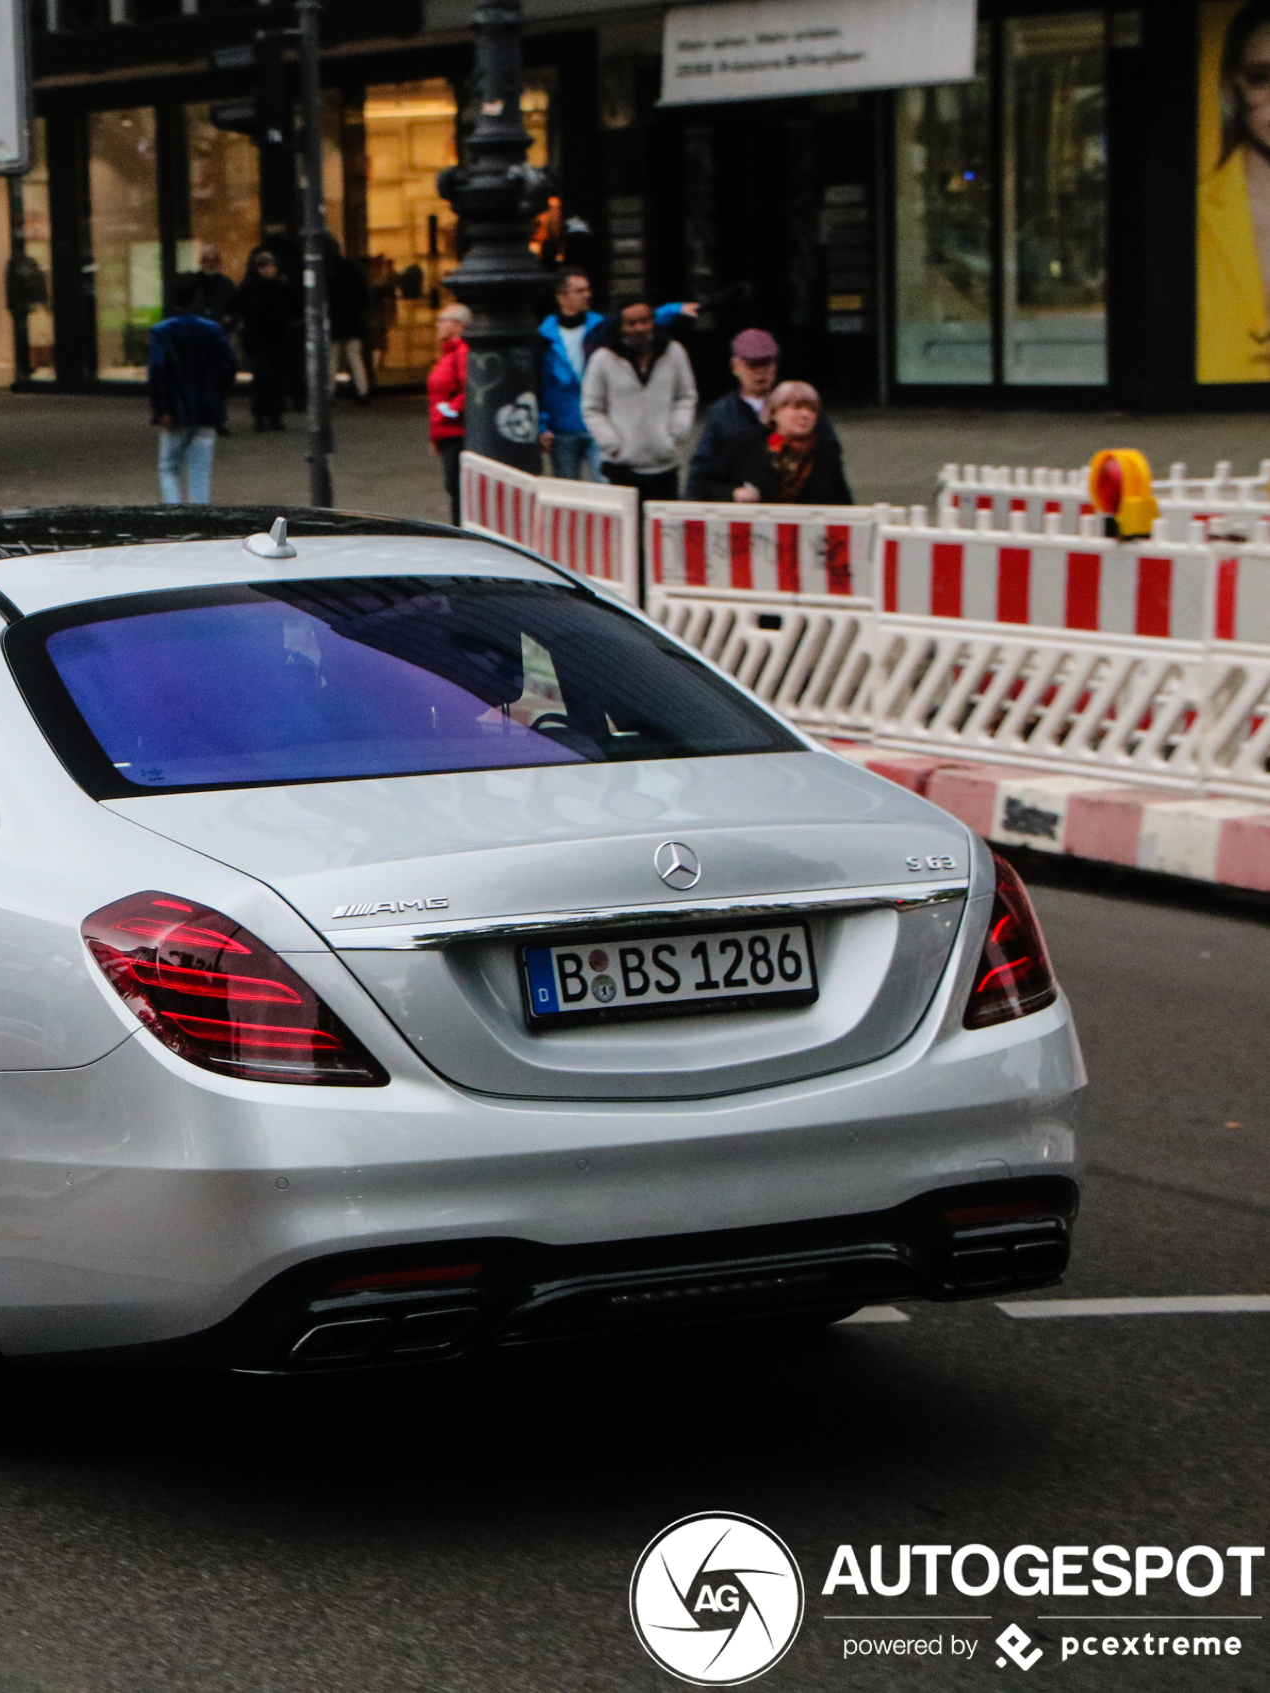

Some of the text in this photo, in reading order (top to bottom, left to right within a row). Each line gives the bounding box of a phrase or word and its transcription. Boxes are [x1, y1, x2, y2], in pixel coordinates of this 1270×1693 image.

[905, 854, 956, 871] S 63
[369, 897, 449, 915] AMG
[556, 933, 802, 1003] B BS 1286
